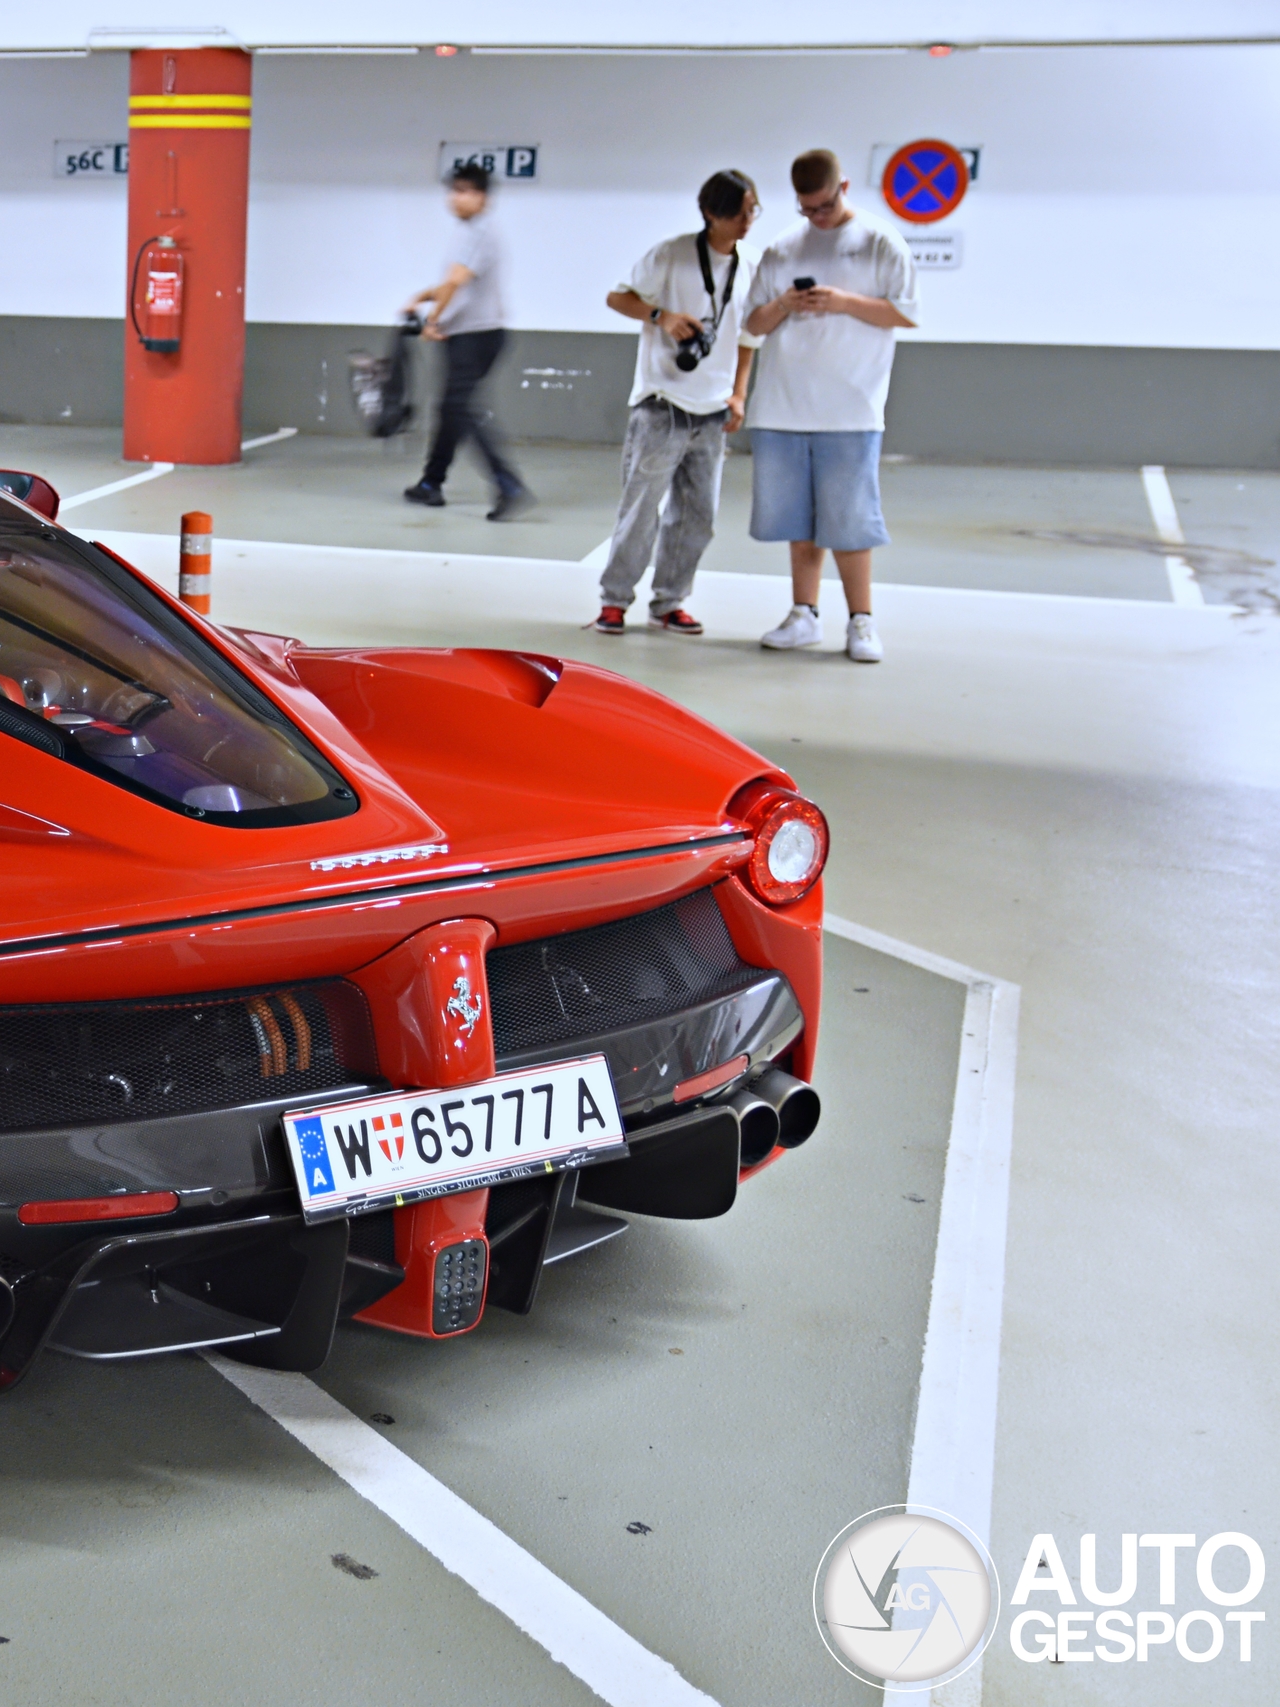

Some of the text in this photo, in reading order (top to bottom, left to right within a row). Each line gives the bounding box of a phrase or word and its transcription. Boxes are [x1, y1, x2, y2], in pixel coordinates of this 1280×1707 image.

[66, 151, 104, 174] 56C
[512, 148, 533, 175] P
[313, 1167, 328, 1188] A
[333, 1118, 373, 1182] W
[410, 1083, 554, 1165] 65777
[417, 1183, 449, 1198] SINGEN
[457, 1172, 502, 1190] STUTTGART
[510, 1165, 533, 1179] WIEN
